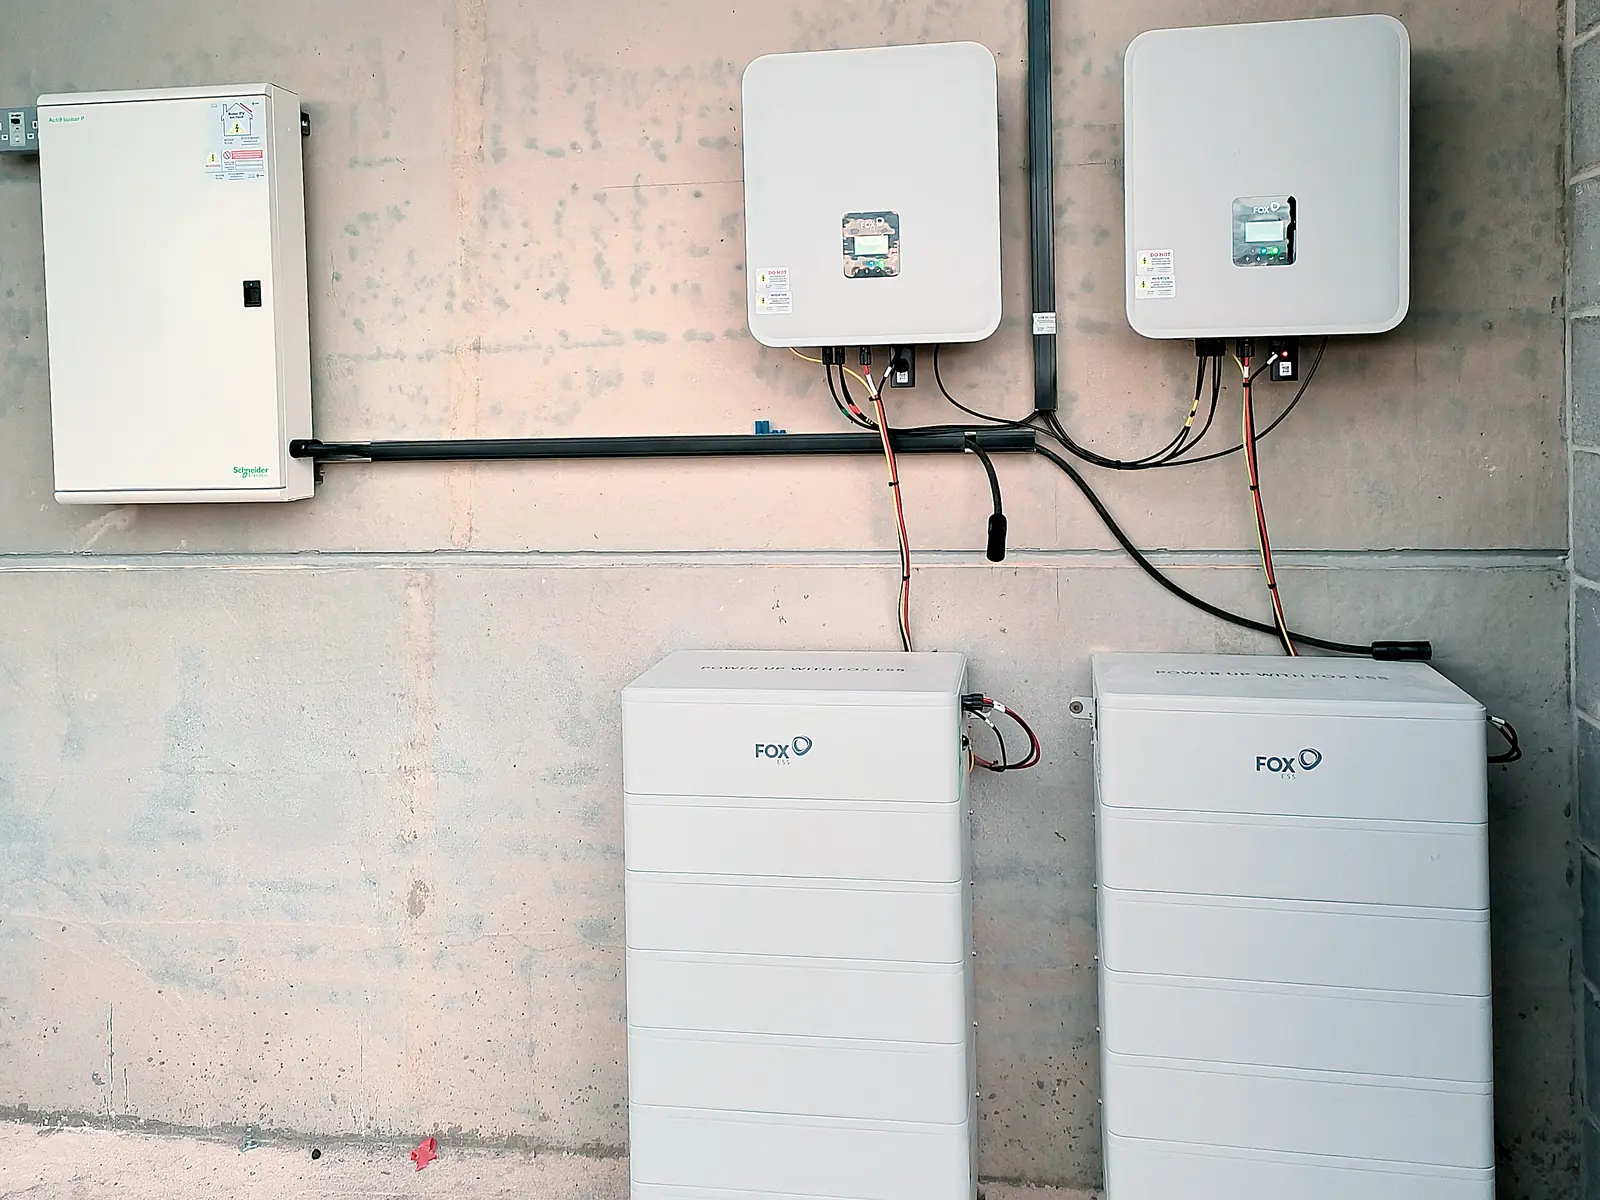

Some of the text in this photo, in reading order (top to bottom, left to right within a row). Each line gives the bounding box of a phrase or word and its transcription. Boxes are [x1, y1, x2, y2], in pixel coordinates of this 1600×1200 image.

[1253, 206, 1270, 214] FOX
[860, 221, 876, 229] FOX
[233, 466, 269, 477] Schneider
[755, 743, 790, 759] FOX
[1256, 756, 1296, 773] FOX
